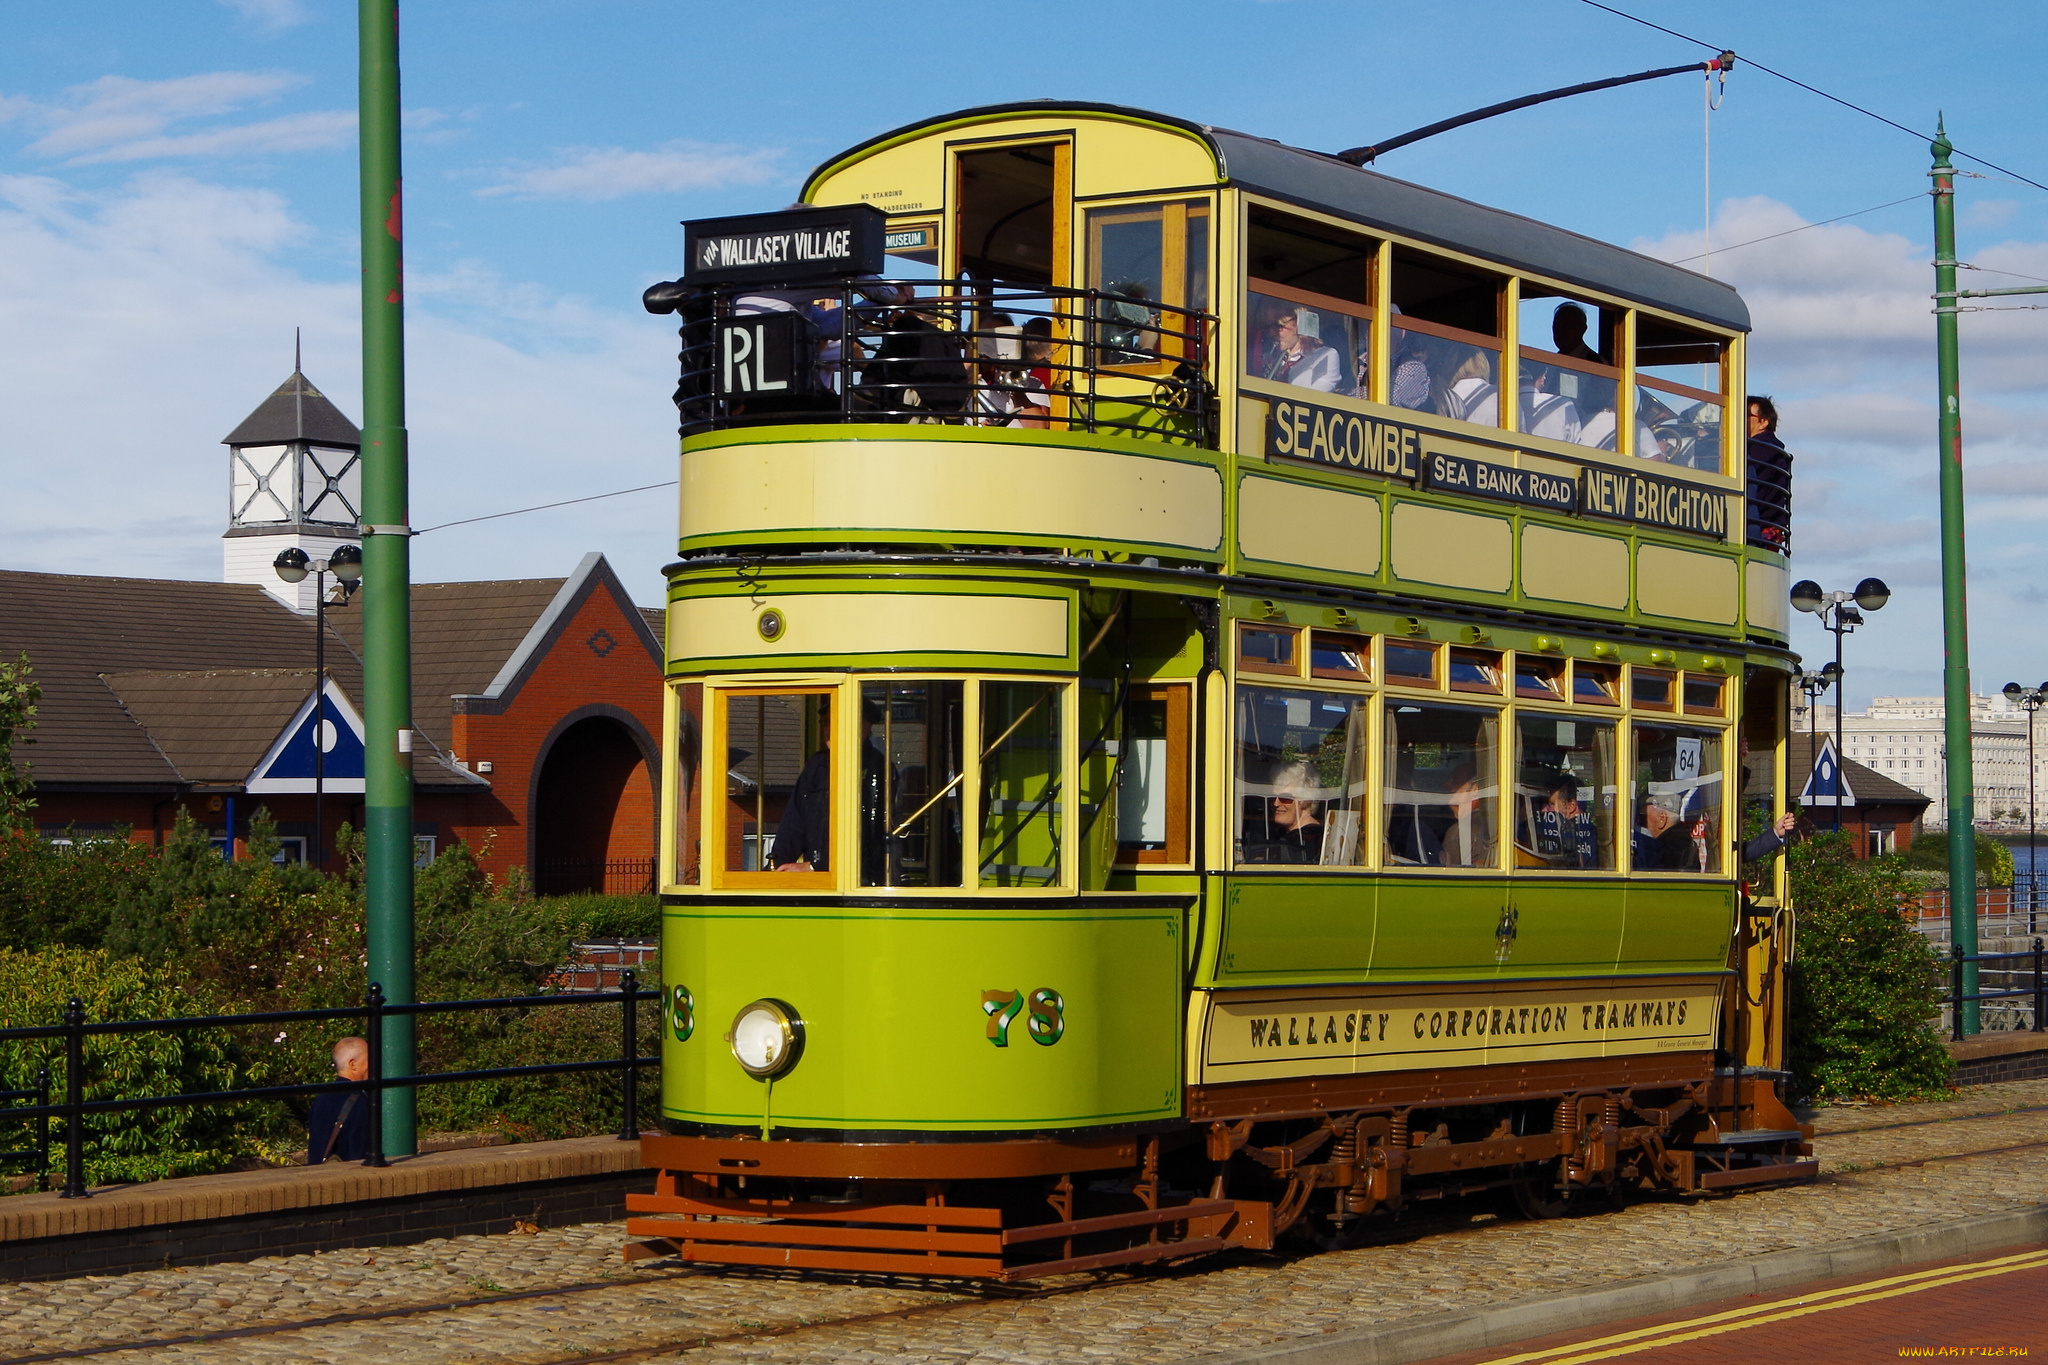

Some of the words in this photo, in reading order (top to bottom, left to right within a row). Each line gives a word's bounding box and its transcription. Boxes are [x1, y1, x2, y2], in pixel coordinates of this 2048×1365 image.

[702, 240, 719, 267] VIA
[720, 235, 790, 267] WALLASEY
[794, 230, 851, 261] VILLAGE
[885, 231, 921, 248] MUSEUM
[723, 324, 788, 393] RL
[1275, 401, 1417, 477] SEACOMBE
[1434, 455, 1470, 487] SEA
[1476, 466, 1522, 496] BANK
[1529, 474, 1571, 504] ROAD
[1586, 470, 1626, 514] NEW
[1635, 478, 1725, 534] BRIGHTON
[1680, 748, 1694, 772] 64
[981, 987, 1065, 1048] 78
[1250, 1012, 1390, 1048] WALLASEY
[1413, 1005, 1567, 1040] CORPORATION
[1582, 999, 1688, 1031] TRAMWAYS
